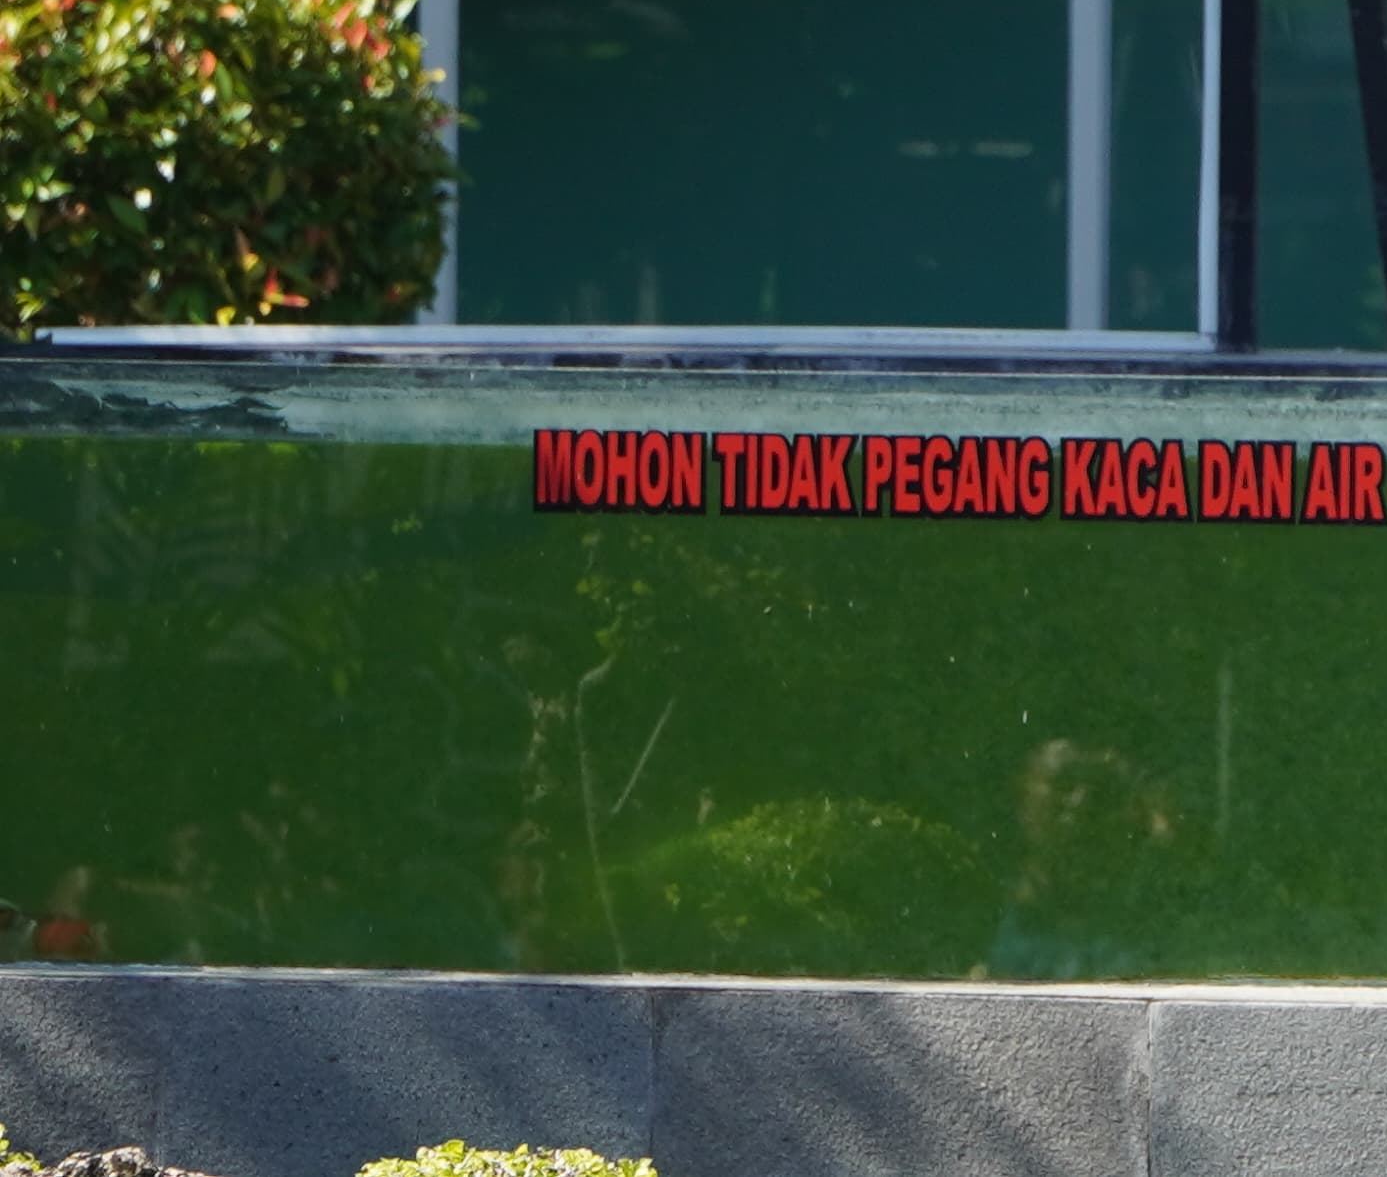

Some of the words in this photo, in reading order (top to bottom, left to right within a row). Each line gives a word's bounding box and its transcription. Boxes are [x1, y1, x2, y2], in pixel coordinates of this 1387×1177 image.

[535, 428, 703, 510] MOHON
[713, 431, 855, 513] TIDAK
[862, 433, 1049, 516] PEGANG
[1062, 437, 1190, 518] KACA
[1199, 440, 1294, 520] DAN
[1302, 442, 1386, 522] AIR
